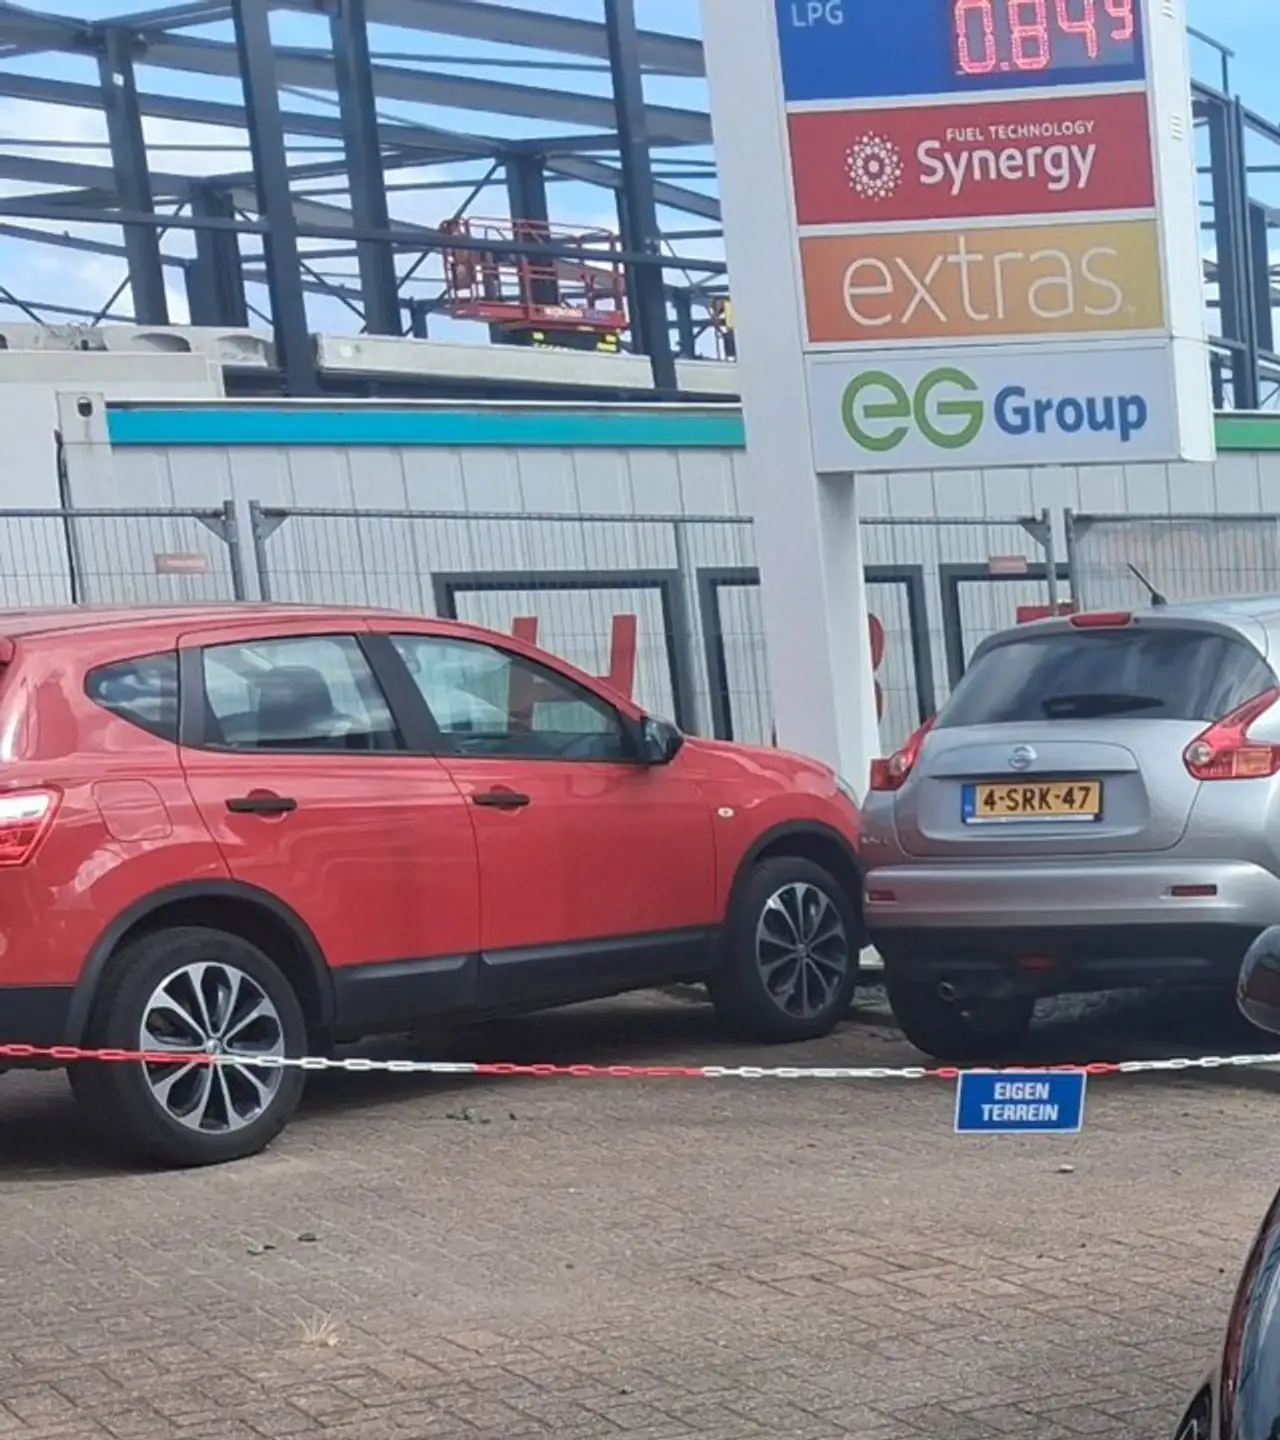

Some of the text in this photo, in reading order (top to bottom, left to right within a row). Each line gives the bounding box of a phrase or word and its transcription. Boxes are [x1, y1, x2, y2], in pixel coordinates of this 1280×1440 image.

[791, 3, 844, 27] LPG
[945, 120, 1096, 143] FUEL TECHNOLOGY
[915, 139, 1097, 196] Synergy
[841, 234, 1124, 327] extras
[993, 385, 1148, 442] Group
[983, 786, 1092, 812] 4-SRK-47
[992, 1081, 1051, 1101] EIGEN
[980, 1103, 1060, 1122] TERREIN
